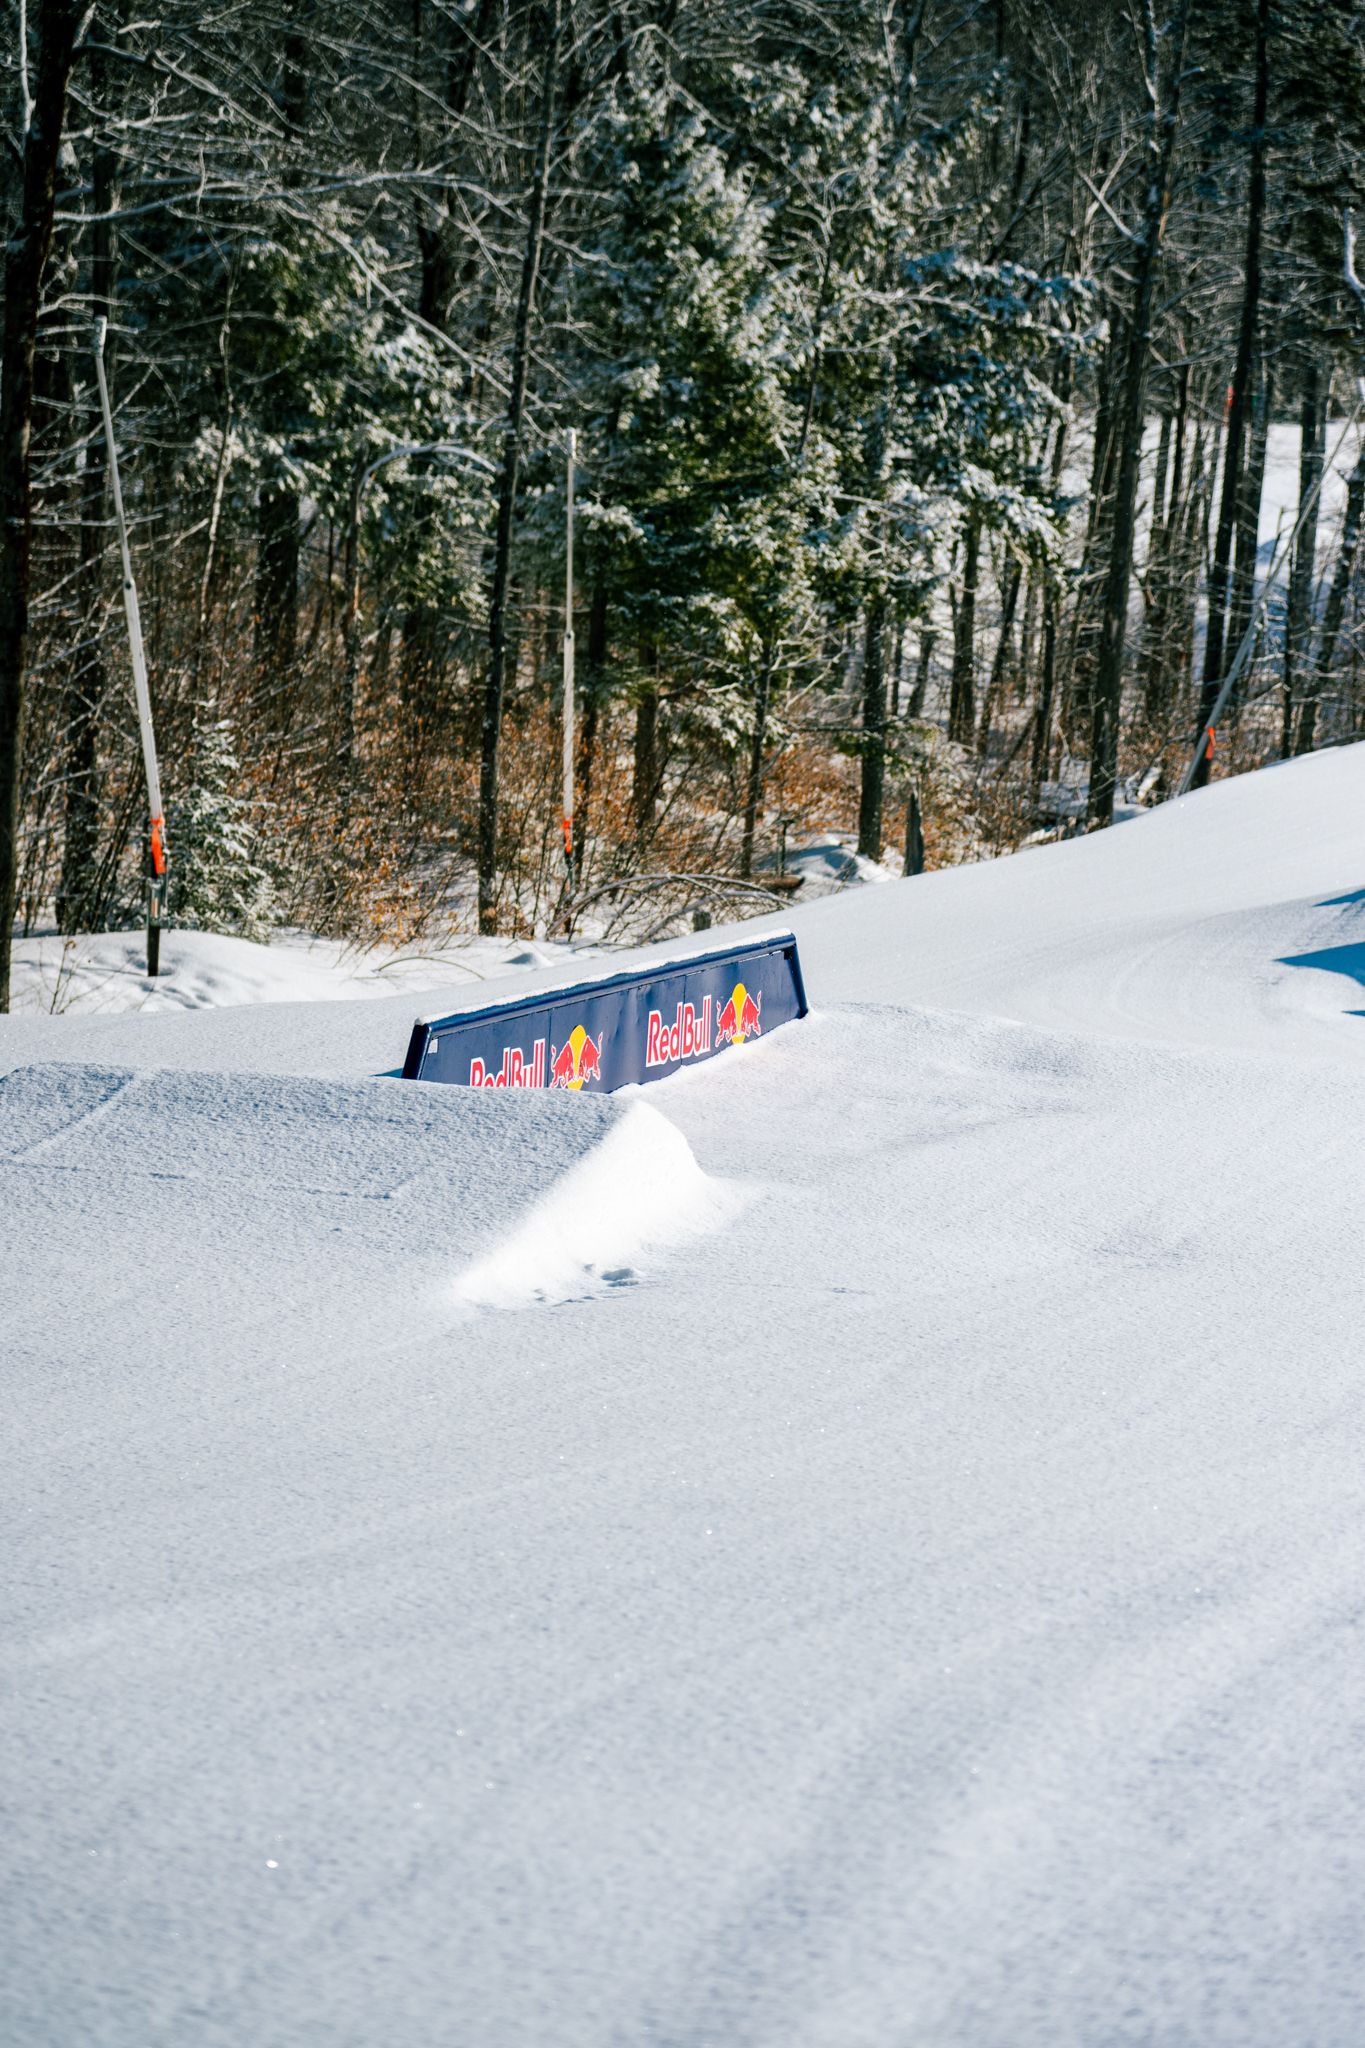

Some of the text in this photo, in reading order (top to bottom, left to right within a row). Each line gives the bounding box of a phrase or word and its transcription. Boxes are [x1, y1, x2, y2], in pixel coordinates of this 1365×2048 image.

[646, 994, 711, 1068] Red Bull
[510, 1038, 545, 1088] Bull
